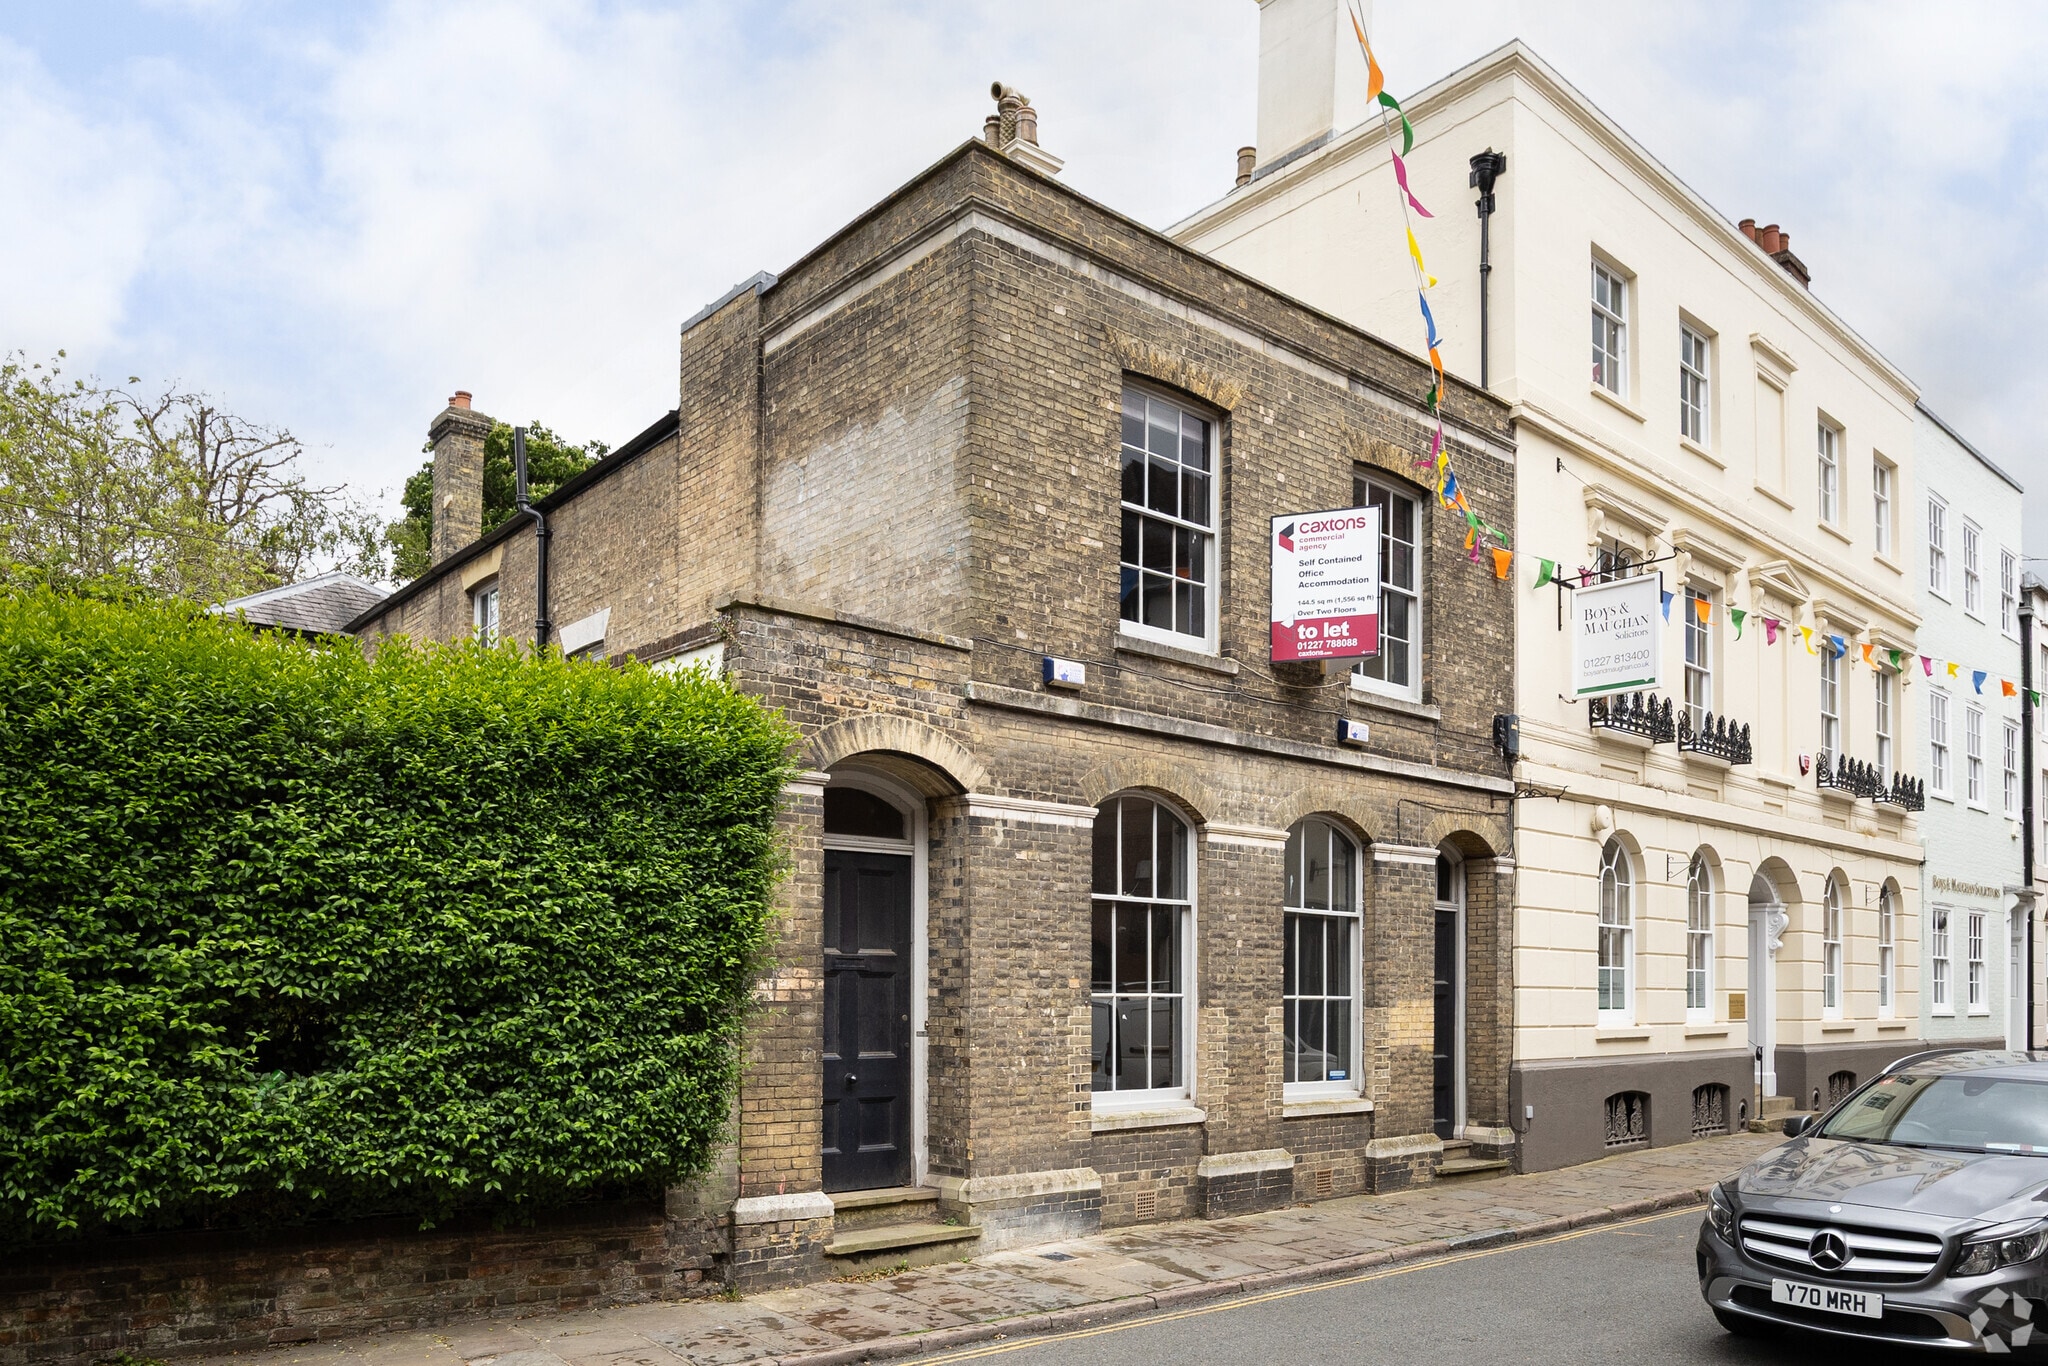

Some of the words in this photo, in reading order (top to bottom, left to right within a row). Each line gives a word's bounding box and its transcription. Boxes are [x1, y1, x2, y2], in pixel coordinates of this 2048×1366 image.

[1299, 517, 1366, 534] caxtons
[1299, 533, 1345, 543] commercial
[1299, 543, 1327, 551] agency
[1298, 558, 1315, 567] Self
[1318, 555, 1362, 565] Contained
[1298, 569, 1324, 578] Office
[1298, 576, 1369, 588] Accommodation
[1334, 596, 1355, 604] (1,556
[1619, 602, 1630, 614] &
[1297, 624, 1318, 639] to
[1323, 621, 1350, 638] let
[1584, 614, 1649, 636] MAUGHAN
[1615, 630, 1649, 641] Solicitors
[1297, 640, 1324, 650] 01227
[1326, 638, 1358, 648] 788088
[1583, 655, 1611, 669] 01227
[1614, 649, 1650, 664] 813400
[1583, 661, 1650, 677] boysandmaughan.co.uk
[1785, 1283, 1821, 1306] Y70
[1826, 1290, 1866, 1313] MRH
